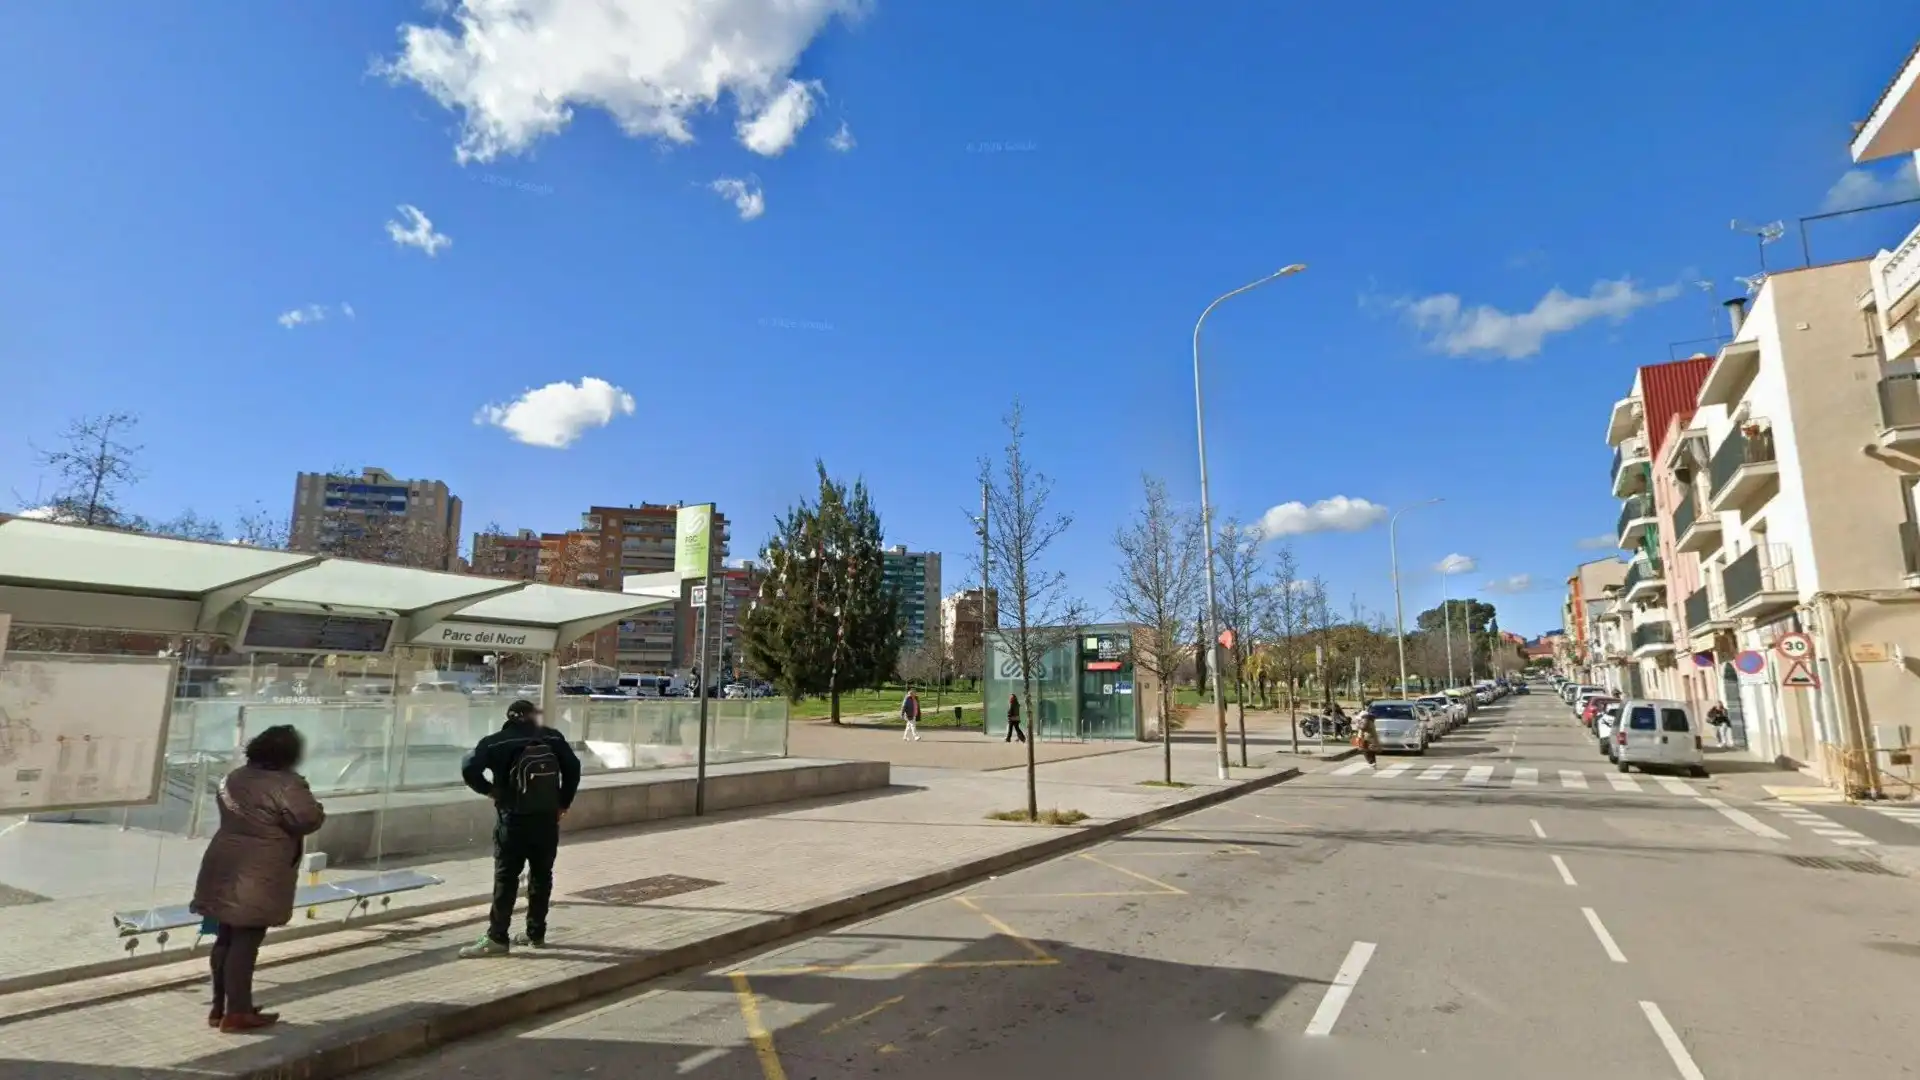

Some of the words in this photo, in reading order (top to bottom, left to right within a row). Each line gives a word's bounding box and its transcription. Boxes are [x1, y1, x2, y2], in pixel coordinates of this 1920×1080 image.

[442, 628, 472, 641] Parc
[475, 631, 494, 642] del
[496, 633, 526, 645] Nord
[1783, 641, 1805, 651] 30
